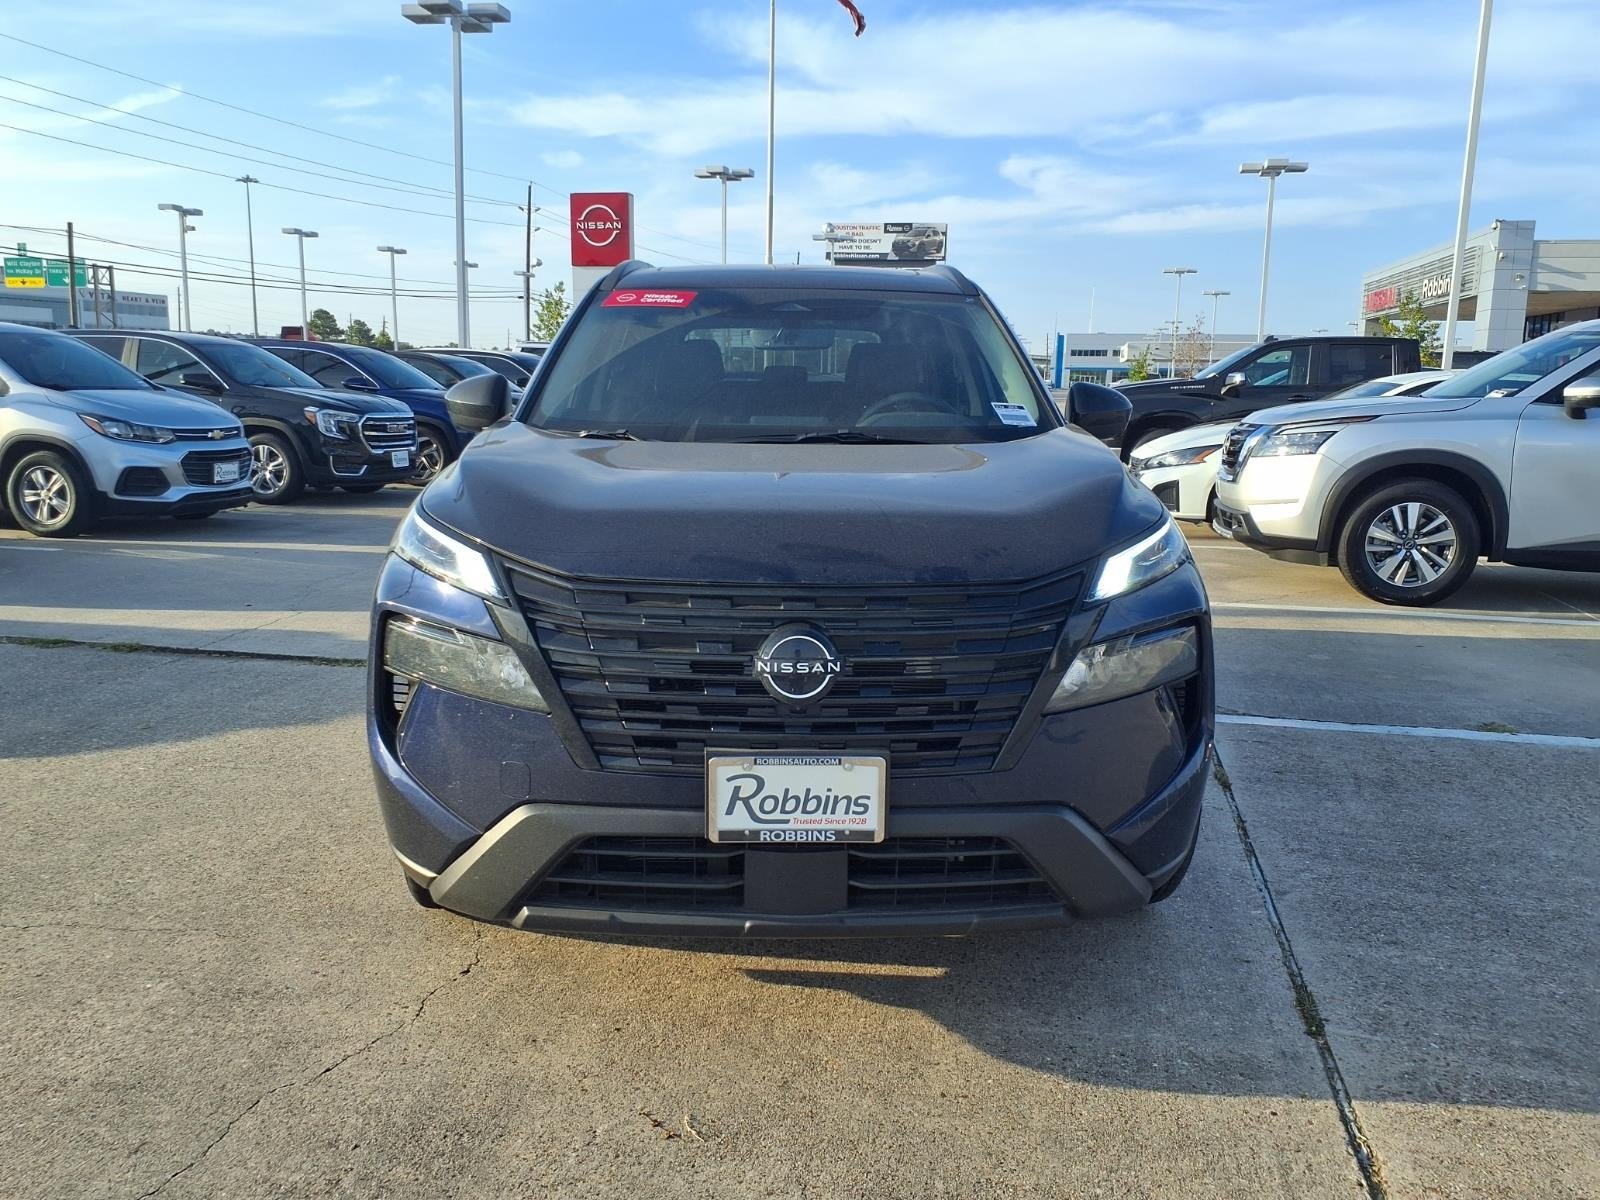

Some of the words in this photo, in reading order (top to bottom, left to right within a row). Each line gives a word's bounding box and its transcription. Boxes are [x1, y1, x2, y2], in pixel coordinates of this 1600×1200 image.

[576, 221, 621, 229] NISSAN
[1422, 275, 1452, 299] Robbin
[757, 661, 840, 674] NISSAN
[756, 758, 840, 766] ROBBINSAUTO.COM
[725, 773, 871, 825] Robbins
[793, 817, 823, 825] Trusted
[824, 817, 847, 825] Since
[848, 817, 868, 825] 1928
[760, 830, 836, 842] ROBBINS
